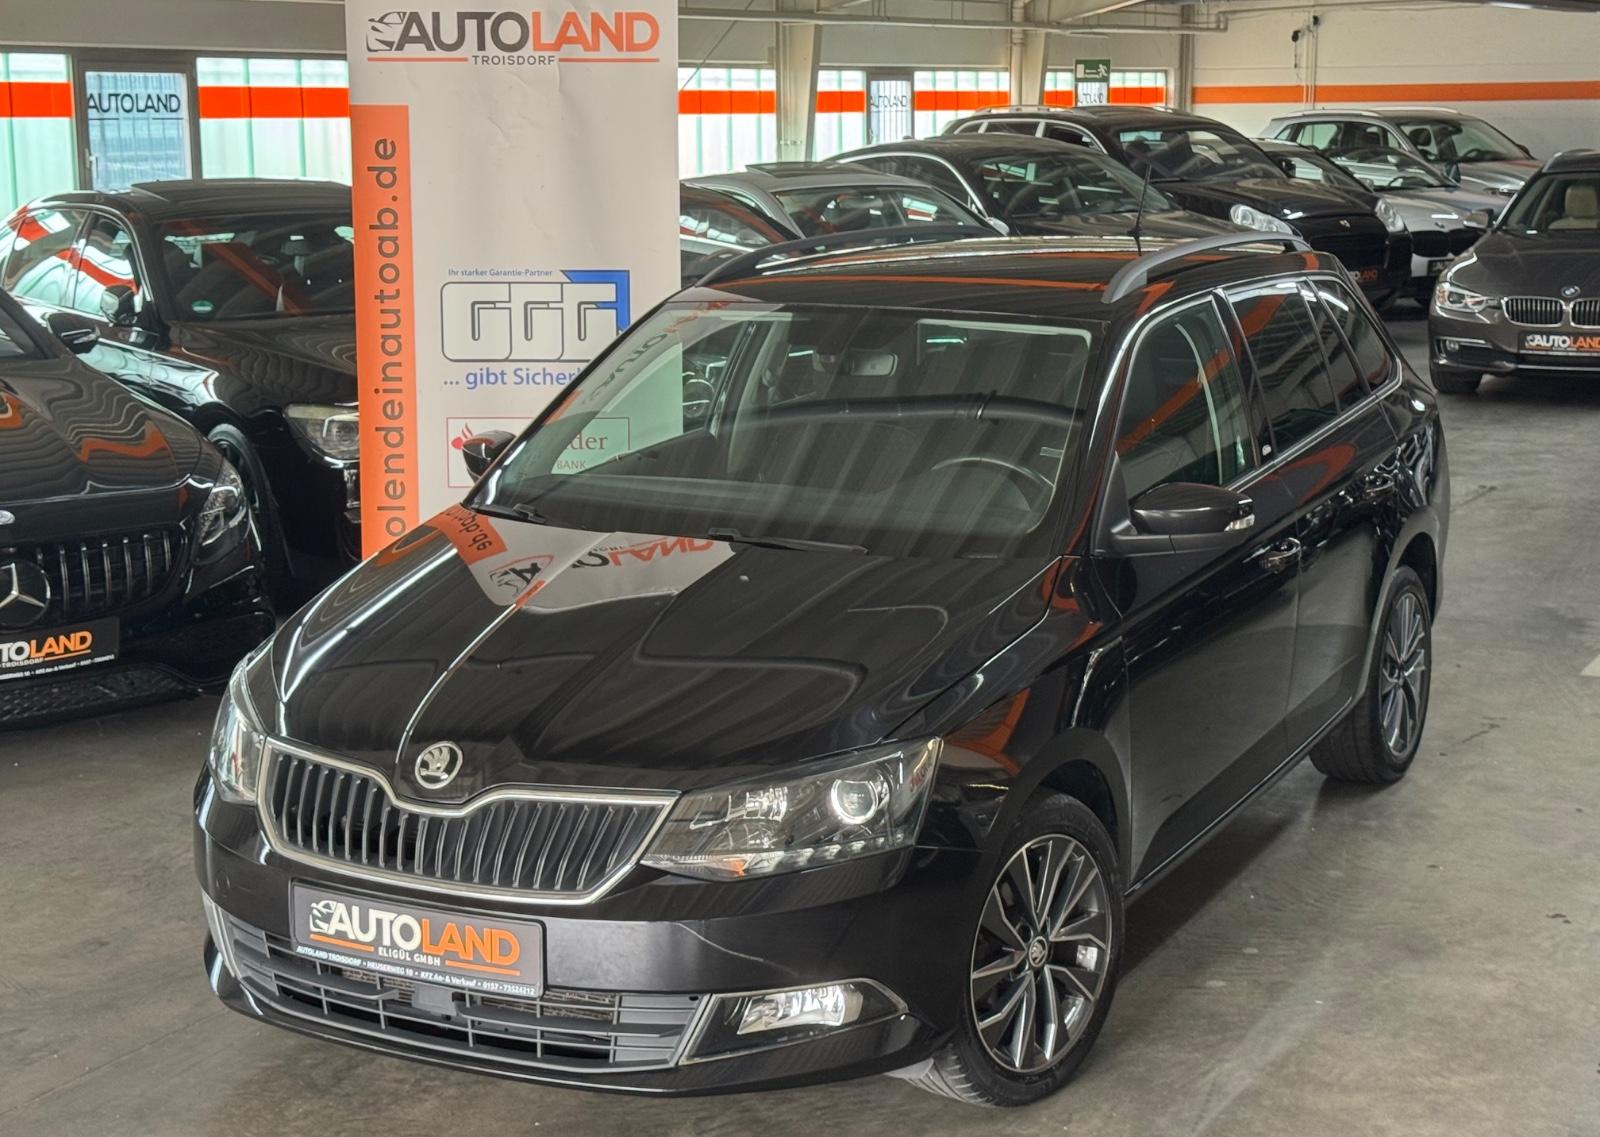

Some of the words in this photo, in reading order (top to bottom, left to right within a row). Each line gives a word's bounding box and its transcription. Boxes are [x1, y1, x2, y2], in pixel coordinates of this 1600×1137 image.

[394, 11, 660, 52] AUTOLAND
[472, 55, 556, 66] TROISDORF
[88, 93, 181, 113] AUTOLAND
[448, 268, 460, 277] Ihr
[461, 268, 488, 277] starker
[489, 268, 553, 277] Garantie-Partner
[465, 367, 507, 390] gibt
[513, 367, 581, 386] Sicher
[556, 460, 586, 470] BANK
[327, 902, 520, 966] AUTOLAND
[413, 953, 441, 967] GMBH
